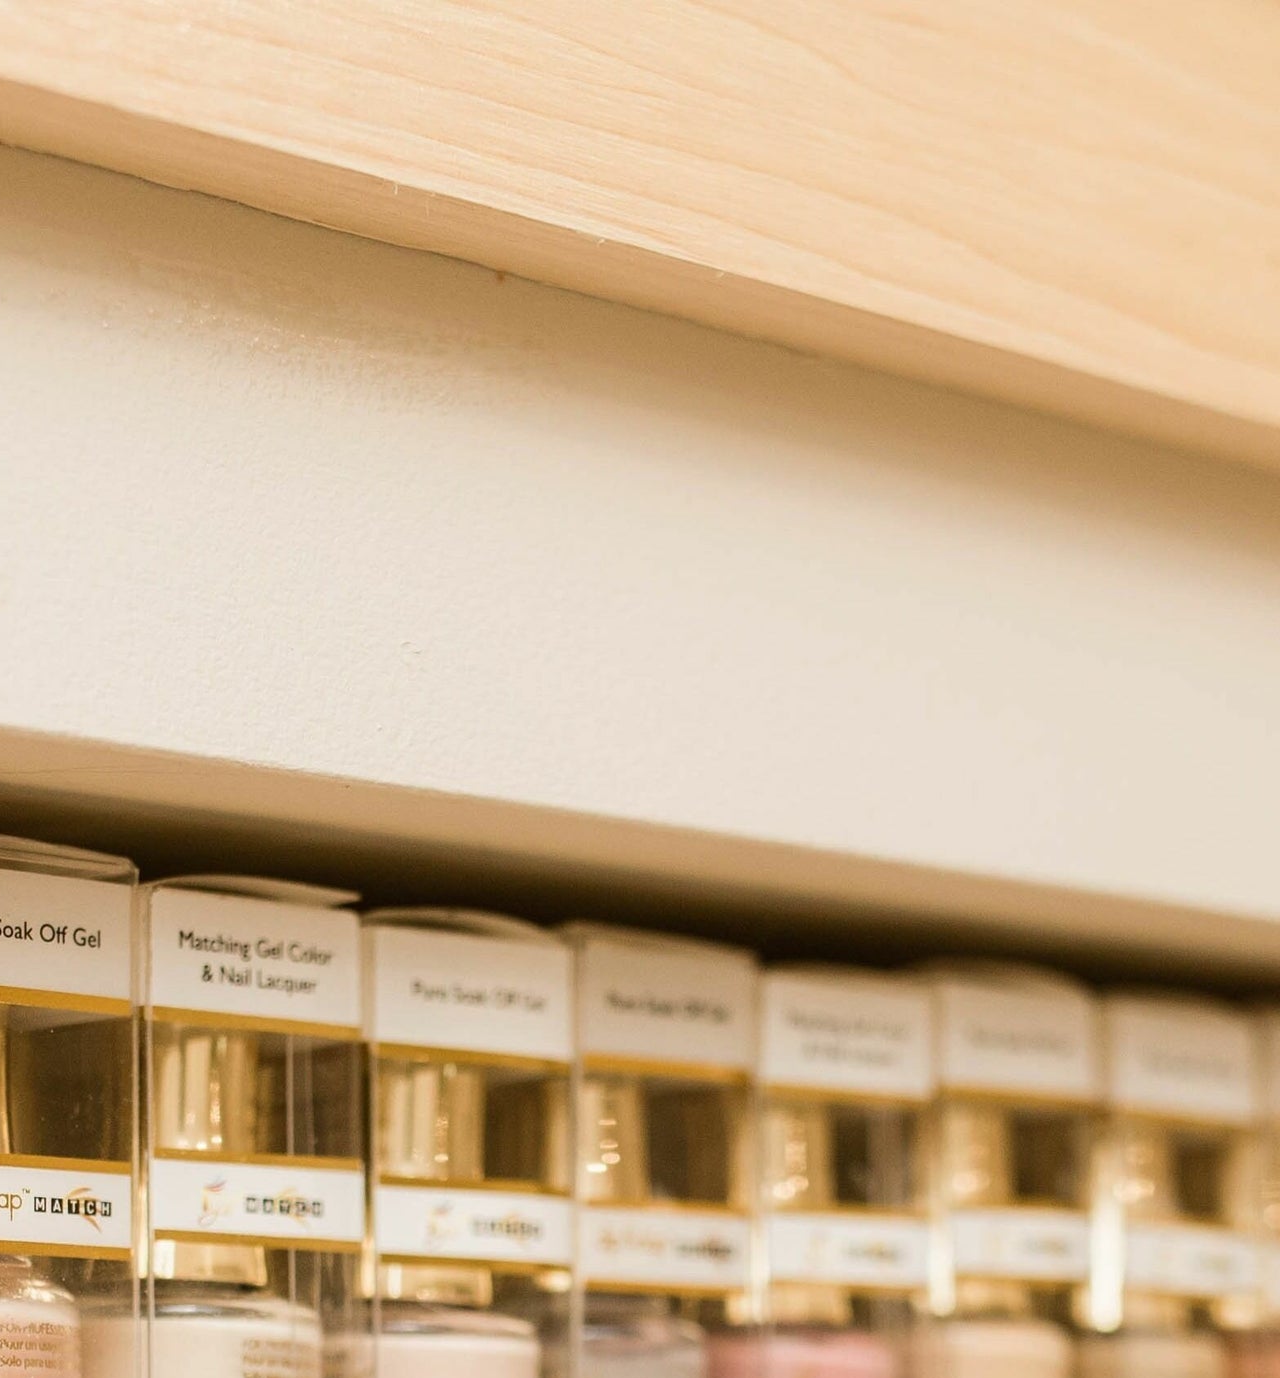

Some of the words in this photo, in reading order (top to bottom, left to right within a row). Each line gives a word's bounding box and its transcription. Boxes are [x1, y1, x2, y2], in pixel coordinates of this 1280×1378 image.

[39, 923, 68, 944] Off
[73, 927, 101, 948] Gel
[178, 930, 251, 962] Matching
[255, 939, 284, 959] Gel
[202, 964, 213, 983] &
[220, 965, 251, 987] Nail
[256, 969, 317, 996] Lacquer
[33, 1196, 112, 1217] MATCH
[0, 1355, 21, 1368] Solo
